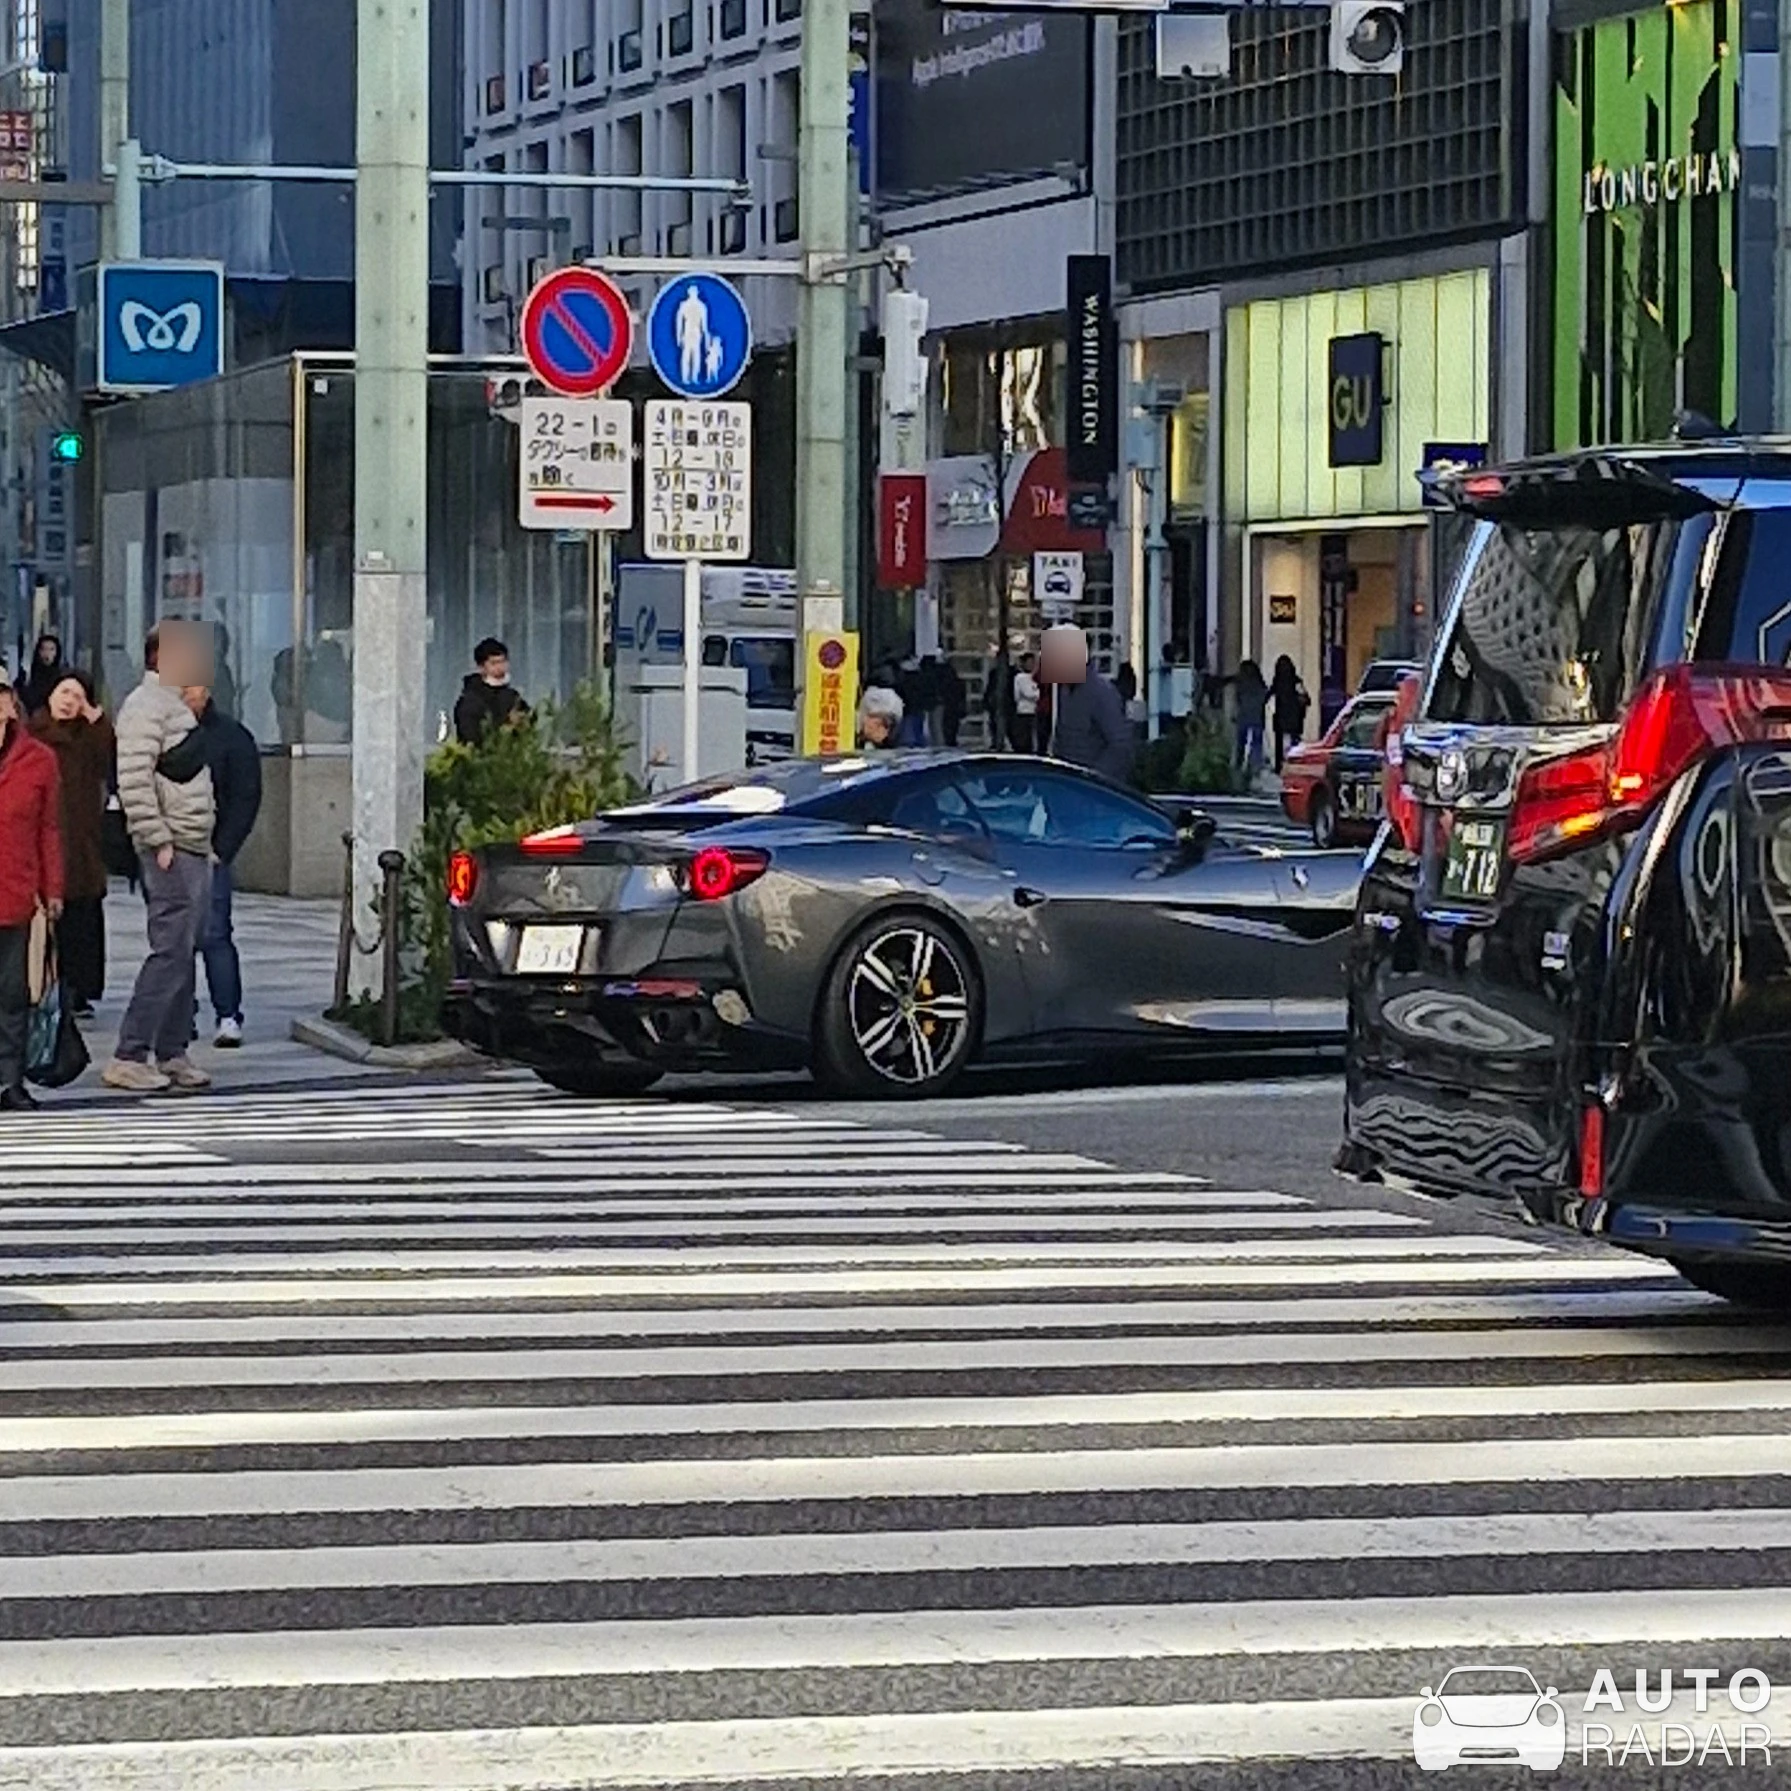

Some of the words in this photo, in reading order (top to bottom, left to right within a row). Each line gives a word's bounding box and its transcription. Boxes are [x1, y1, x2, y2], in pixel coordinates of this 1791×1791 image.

[1082, 293, 1099, 445] WASHINGTON
[1333, 375, 1372, 431] GU
[1041, 555, 1078, 569] TAXI
